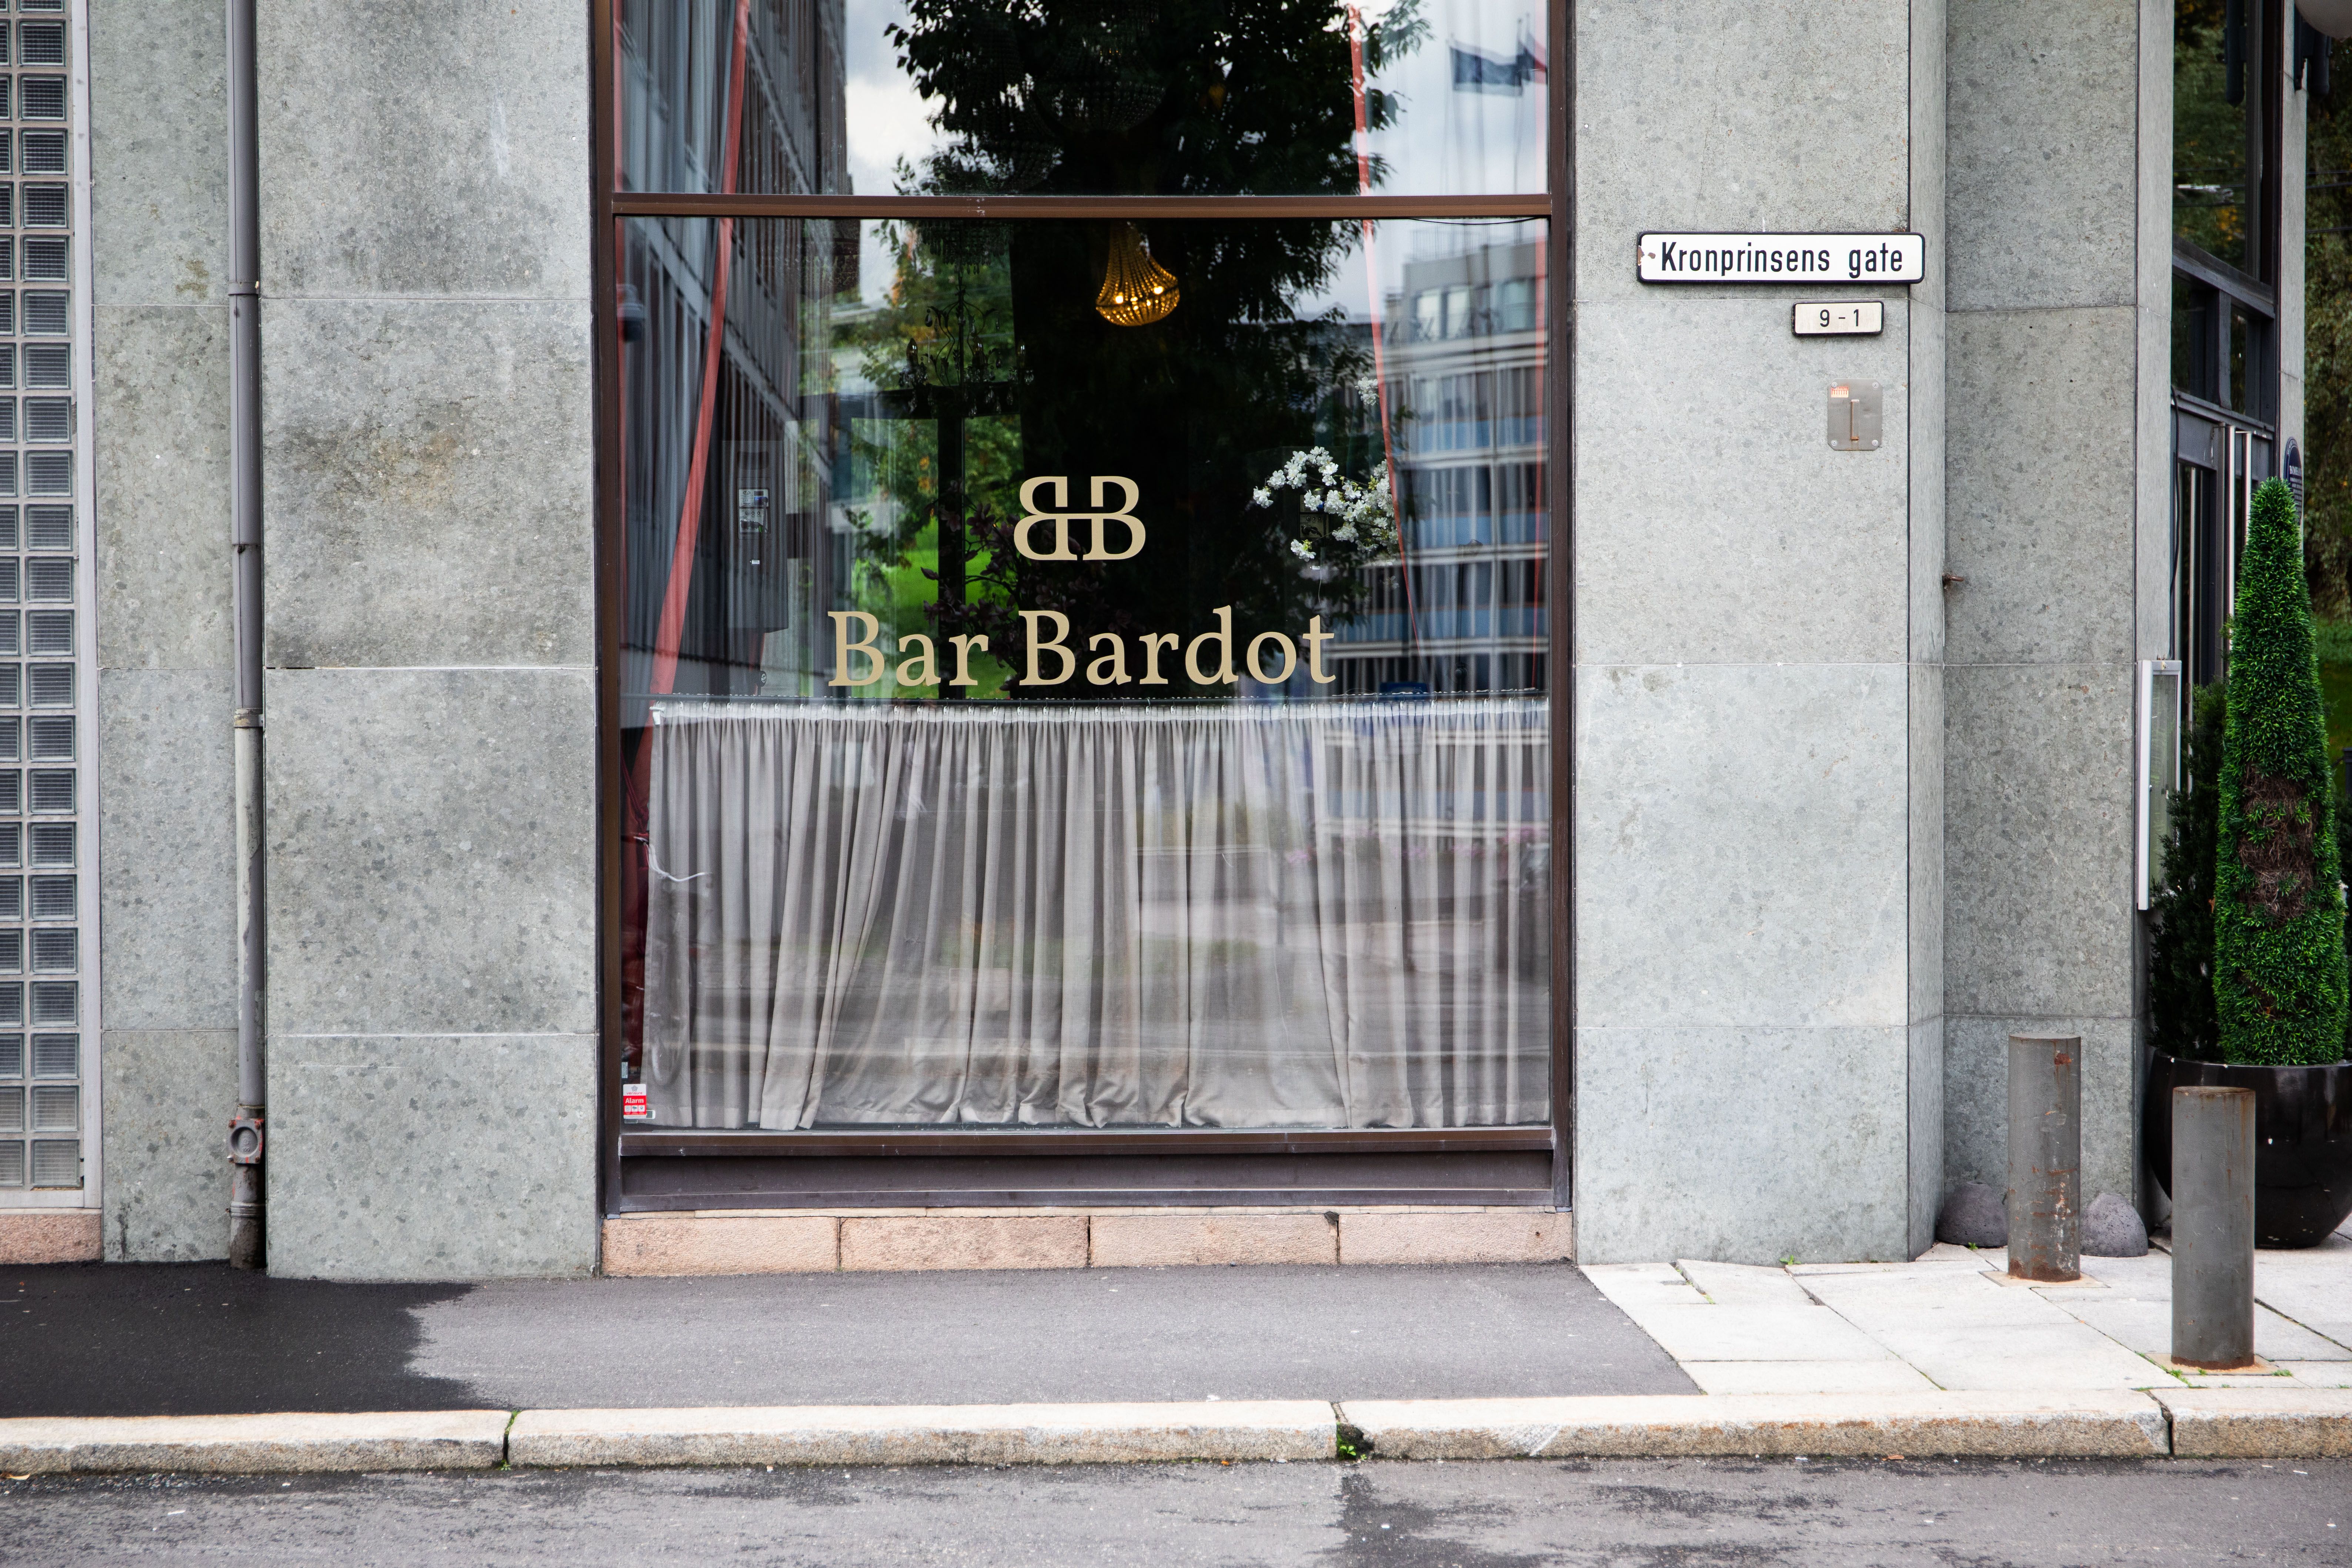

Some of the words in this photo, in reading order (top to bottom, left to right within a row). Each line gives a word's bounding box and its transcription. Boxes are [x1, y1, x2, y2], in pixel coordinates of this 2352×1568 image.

[1662, 242, 1830, 277] Kronprinsens
[1849, 243, 1902, 278] gate
[827, 611, 988, 686] Bar
[1018, 605, 1336, 685] Bardot
